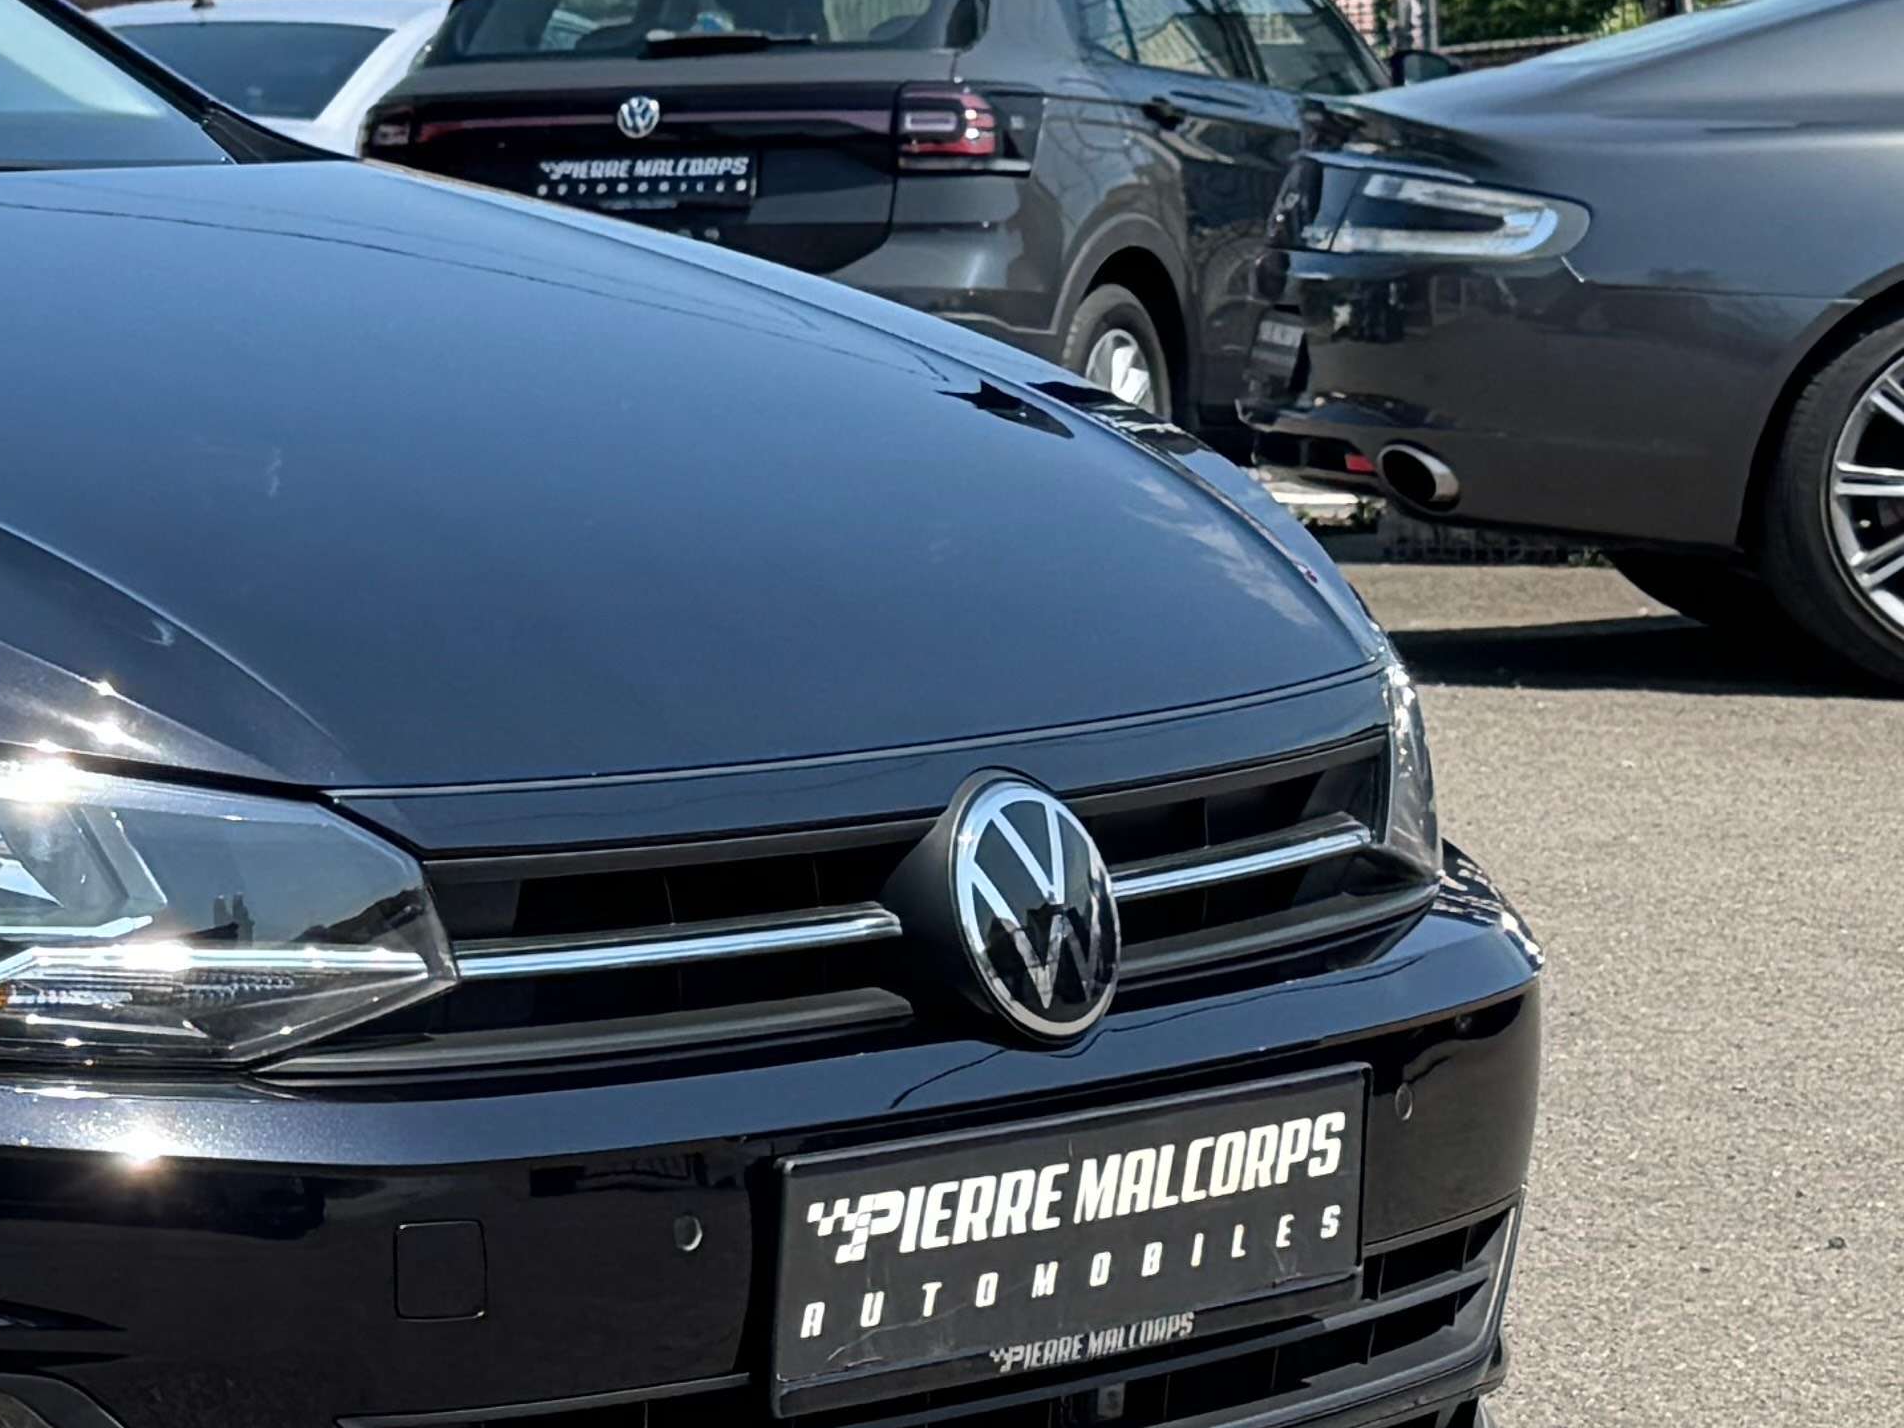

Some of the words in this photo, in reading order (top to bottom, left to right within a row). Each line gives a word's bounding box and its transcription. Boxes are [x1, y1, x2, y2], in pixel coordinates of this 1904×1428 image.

[835, 1162, 1070, 1264] PIERRE
[1074, 1111, 1346, 1223] MALCORPS
[799, 1204, 1341, 1338] AUTOMOBILES
[999, 1334, 1085, 1373] PIERRE
[1087, 1311, 1195, 1358] MALCORPS
